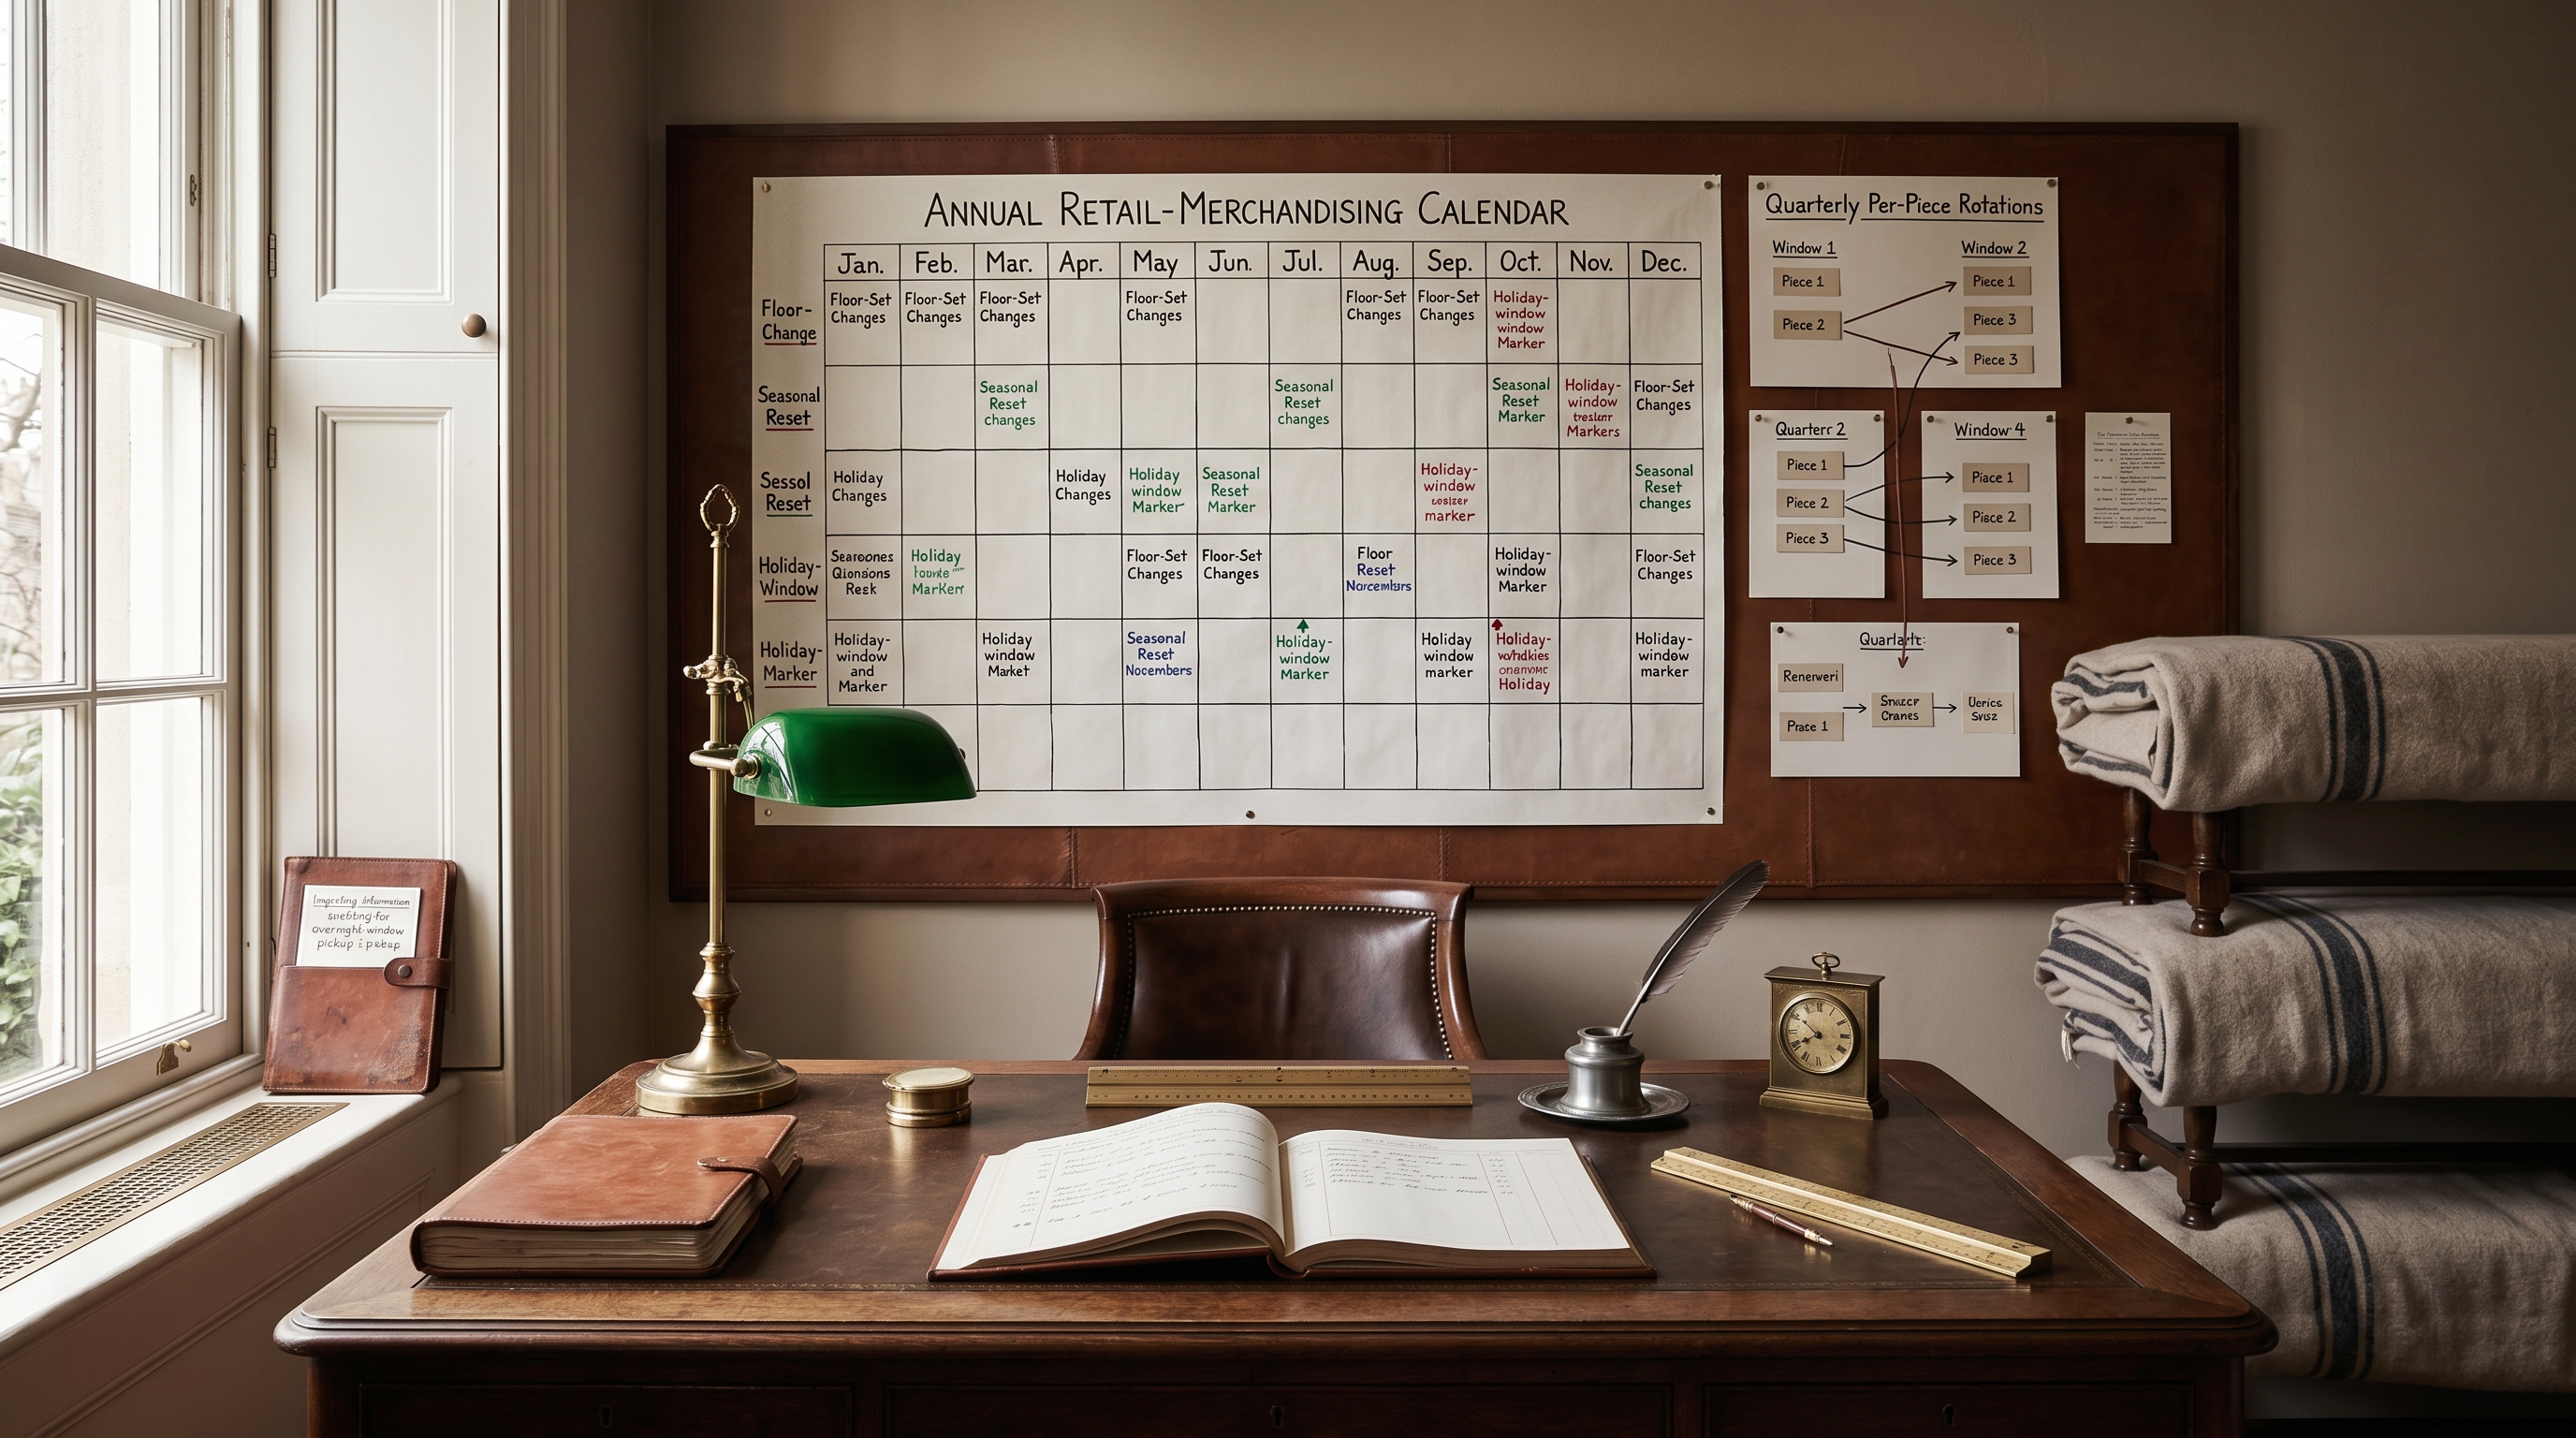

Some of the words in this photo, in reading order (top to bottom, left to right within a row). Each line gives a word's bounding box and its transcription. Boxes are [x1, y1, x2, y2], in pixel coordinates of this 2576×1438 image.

[925, 193, 1042, 227] ANNUAL
[1061, 191, 1403, 226] RETAIL-MERCHANDISING
[1419, 191, 1569, 225] CALENDAR
[1766, 193, 1859, 225] Quarterly
[1869, 193, 1951, 213] Per-Piece
[1960, 193, 2042, 214] Rotations
[1773, 241, 1822, 254] Window
[1827, 241, 1836, 254] 1
[1961, 241, 2012, 254] Window
[2017, 241, 2027, 254] 2
[838, 253, 884, 274] Jan.
[916, 251, 957, 273] Feb.
[988, 251, 1032, 272] Mar.
[1060, 250, 1103, 279] Apr.
[1134, 250, 1178, 278] May
[1213, 250, 1252, 271] Jun.
[1283, 250, 1322, 271] Jul.
[1353, 250, 1399, 279] Aug.
[1427, 249, 1472, 278] Sep.
[1500, 250, 1541, 271] Oct.
[1571, 250, 1613, 271] Nov.
[1642, 250, 1686, 271] Dec.
[1783, 275, 1812, 286] Piece
[1817, 276, 1823, 286] 1
[1974, 275, 2004, 286] Piece
[2008, 276, 2015, 286] 1
[831, 292, 892, 306] Floor-Set
[905, 292, 966, 305] Floor-Set
[981, 291, 1041, 304] Floor-Set
[1127, 291, 1187, 303] Floor-Set
[1347, 290, 1406, 302] Floor-Set
[1419, 290, 1480, 303] Floor-Set
[1494, 290, 1548, 310] Holiday-
[763, 300, 812, 316] Floor-
[1496, 307, 1545, 318] window
[831, 311, 886, 329] Changes
[907, 310, 961, 328] Changes
[980, 309, 1035, 328] Changes
[1127, 308, 1181, 327] Changes
[1347, 308, 1400, 325] Changes
[1420, 308, 1474, 326] Changes
[1974, 314, 2003, 325] Piece
[2009, 314, 2016, 325] 3
[1498, 322, 1544, 333] window
[1783, 318, 1812, 330] Piece
[1817, 319, 1824, 330] 2
[763, 323, 816, 345] Change
[1499, 337, 1544, 348] Marker
[1974, 353, 2005, 365] Piece
[2010, 354, 2017, 365] 3
[980, 380, 1037, 393] Seasonal
[1275, 379, 1333, 392] Seasonal
[1492, 377, 1549, 390] Seasonal
[1566, 378, 1620, 395] Holiday-
[1634, 379, 1694, 392] Floor-Set
[758, 386, 820, 403] Seasonal
[1503, 394, 1539, 406] Reset
[1568, 395, 1617, 407] window
[990, 397, 1026, 409] Reset
[1285, 396, 1321, 408] Reset
[1637, 398, 1690, 416] Changes
[767, 408, 811, 425] Reset
[985, 414, 1035, 430] changes
[1279, 412, 1329, 429] changes
[1499, 410, 1545, 422] Marker
[1567, 425, 1619, 437] Markers
[1837, 422, 1846, 435] 2
[2015, 422, 2025, 436] 4
[1635, 464, 1692, 477] Seasonal
[1788, 459, 1816, 470] Piece
[1822, 460, 1826, 470] 1
[1057, 469, 1105, 487] Holiday
[1130, 467, 1179, 487] Holiday
[1203, 467, 1259, 479] Seasonal
[1422, 462, 1477, 482] Holiday-
[2007, 472, 2013, 482] 1
[760, 471, 810, 489] Sessol
[834, 470, 883, 488] Holiday
[1424, 478, 1475, 492] window
[1132, 484, 1181, 496] window
[1212, 483, 1249, 496] Reset
[1646, 480, 1682, 492] Reset
[767, 493, 811, 511] Reset
[832, 488, 886, 506] Changes
[1056, 487, 1111, 506] Changes
[1787, 496, 1816, 508] Piece
[1821, 497, 1829, 508] 2
[1134, 501, 1184, 512] Marker
[1208, 501, 1255, 512] Marker
[1640, 496, 1690, 512] changes
[1426, 510, 1475, 521] marker
[2008, 511, 2016, 522] 2
[1787, 532, 1815, 544] Piece
[1820, 533, 1828, 544] 3
[912, 549, 960, 566] Holiday
[1128, 550, 1187, 562] Floor-Set
[1203, 550, 1262, 562] Floor-Set
[1358, 547, 1393, 559] Floor
[1496, 547, 1551, 565] Holiday-
[1636, 550, 1696, 563] Floor-Set
[1974, 554, 2003, 565] Piece
[2009, 554, 2016, 565] 3
[759, 556, 821, 575] Holiday-
[1357, 564, 1396, 576] Reset
[1497, 564, 1545, 576] window
[1128, 567, 1182, 584] Changes
[1204, 566, 1259, 584] Changes
[1638, 567, 1692, 584] Changes
[760, 579, 818, 595] Window
[1500, 580, 1546, 592] Marker
[835, 633, 890, 651] Holiday-
[983, 632, 1032, 650] Holiday
[1127, 631, 1185, 644] Seasonal
[1277, 635, 1332, 653] Holiday-
[1422, 632, 1471, 652] Holiday
[1497, 632, 1551, 652] Holiday-
[1636, 632, 1691, 650] Holiday-
[761, 641, 822, 660] Holiday-
[837, 645, 887, 662] window
[1138, 648, 1174, 660] Reset
[1425, 649, 1473, 662] window
[1639, 649, 1689, 661] window
[1280, 652, 1329, 664] window
[764, 665, 817, 681] Marker
[851, 665, 873, 676] and
[1281, 668, 1329, 680] Marker
[1426, 666, 1473, 678] marker
[1642, 665, 1689, 677] marker
[839, 680, 887, 692] Marker
[1500, 678, 1550, 695] Holiday
[1822, 721, 1828, 731] 1
[317, 938, 353, 951] pickup
